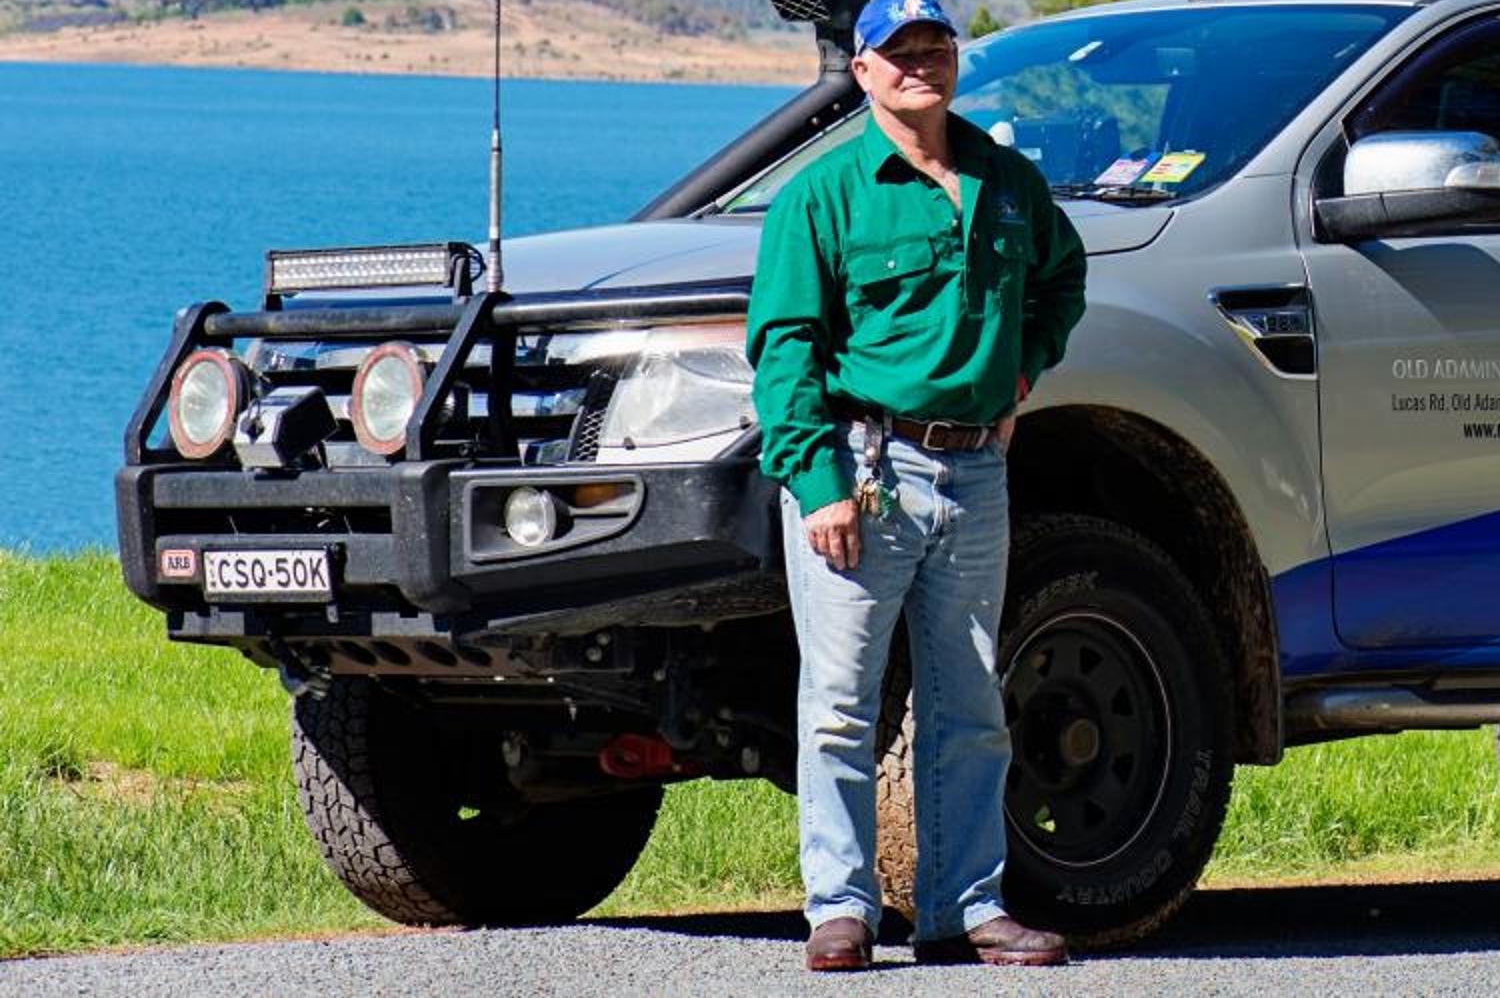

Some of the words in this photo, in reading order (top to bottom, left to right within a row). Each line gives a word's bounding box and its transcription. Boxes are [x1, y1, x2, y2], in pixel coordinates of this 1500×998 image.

[1391, 359, 1429, 379] OLD
[1391, 393, 1426, 411] Lucas
[1451, 393, 1471, 411] Old
[167, 556, 191, 570] ARB
